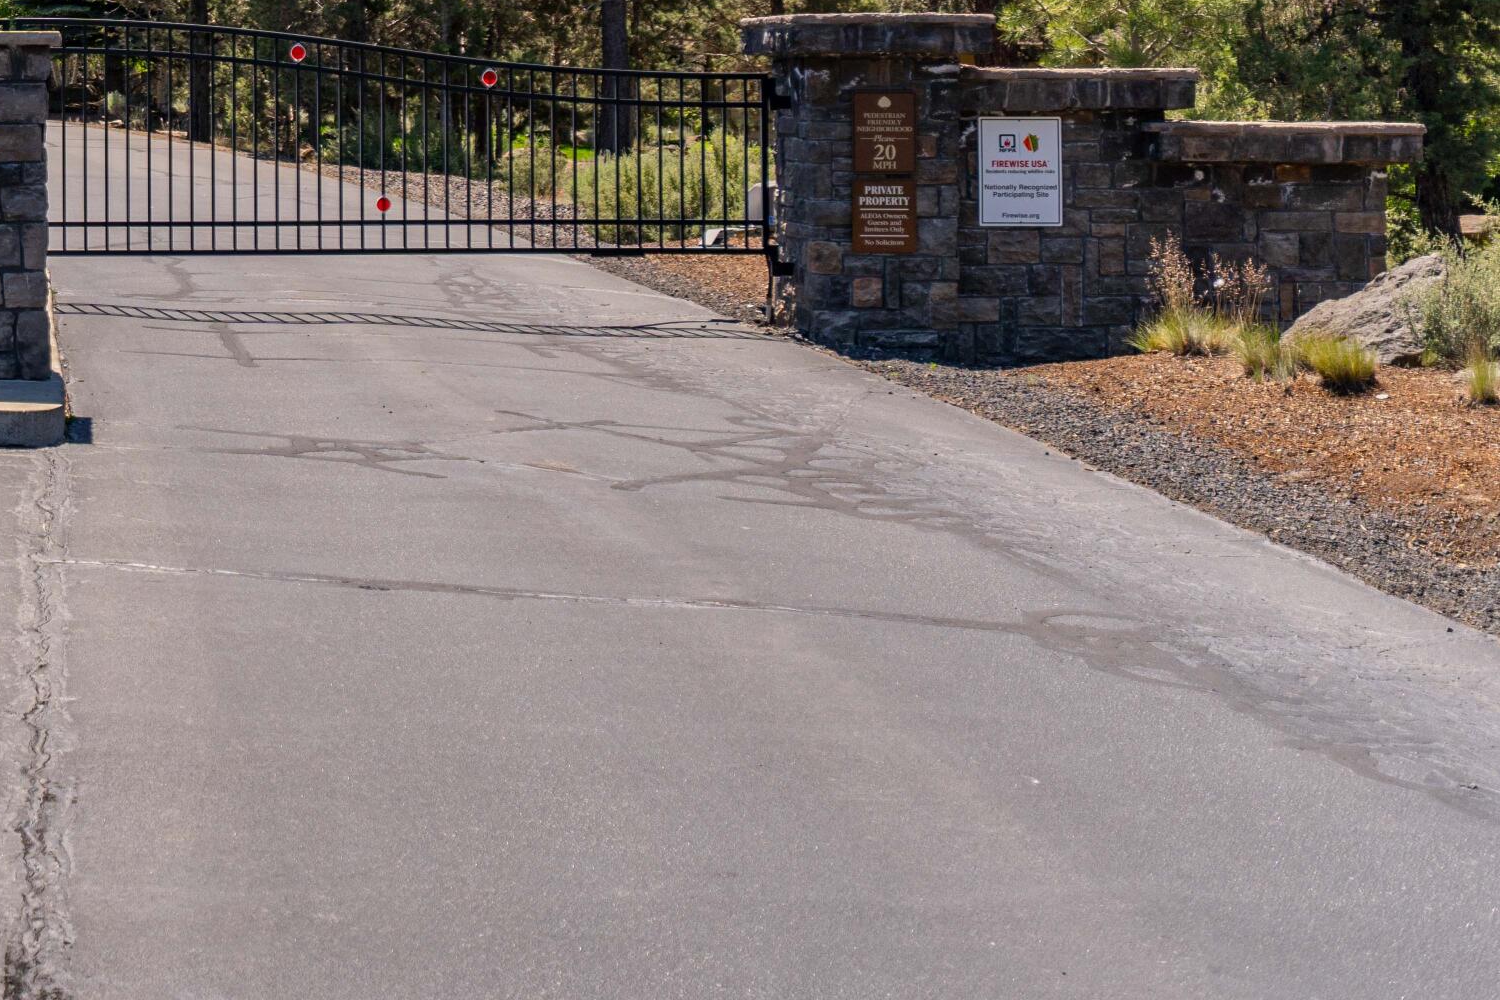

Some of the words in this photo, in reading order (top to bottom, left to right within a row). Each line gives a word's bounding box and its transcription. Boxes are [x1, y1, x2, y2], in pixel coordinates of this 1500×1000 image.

[874, 134, 895, 142] Please
[873, 144, 896, 160] 20
[872, 161, 897, 169] MPH
[991, 160, 1030, 168] FIREWISE
[864, 185, 904, 195] PRIVATE
[1018, 184, 1058, 192] Recognized
[859, 196, 910, 206] PROPERTY
[1002, 212, 1041, 220] Firewise.org
[889, 226, 905, 234] Only
